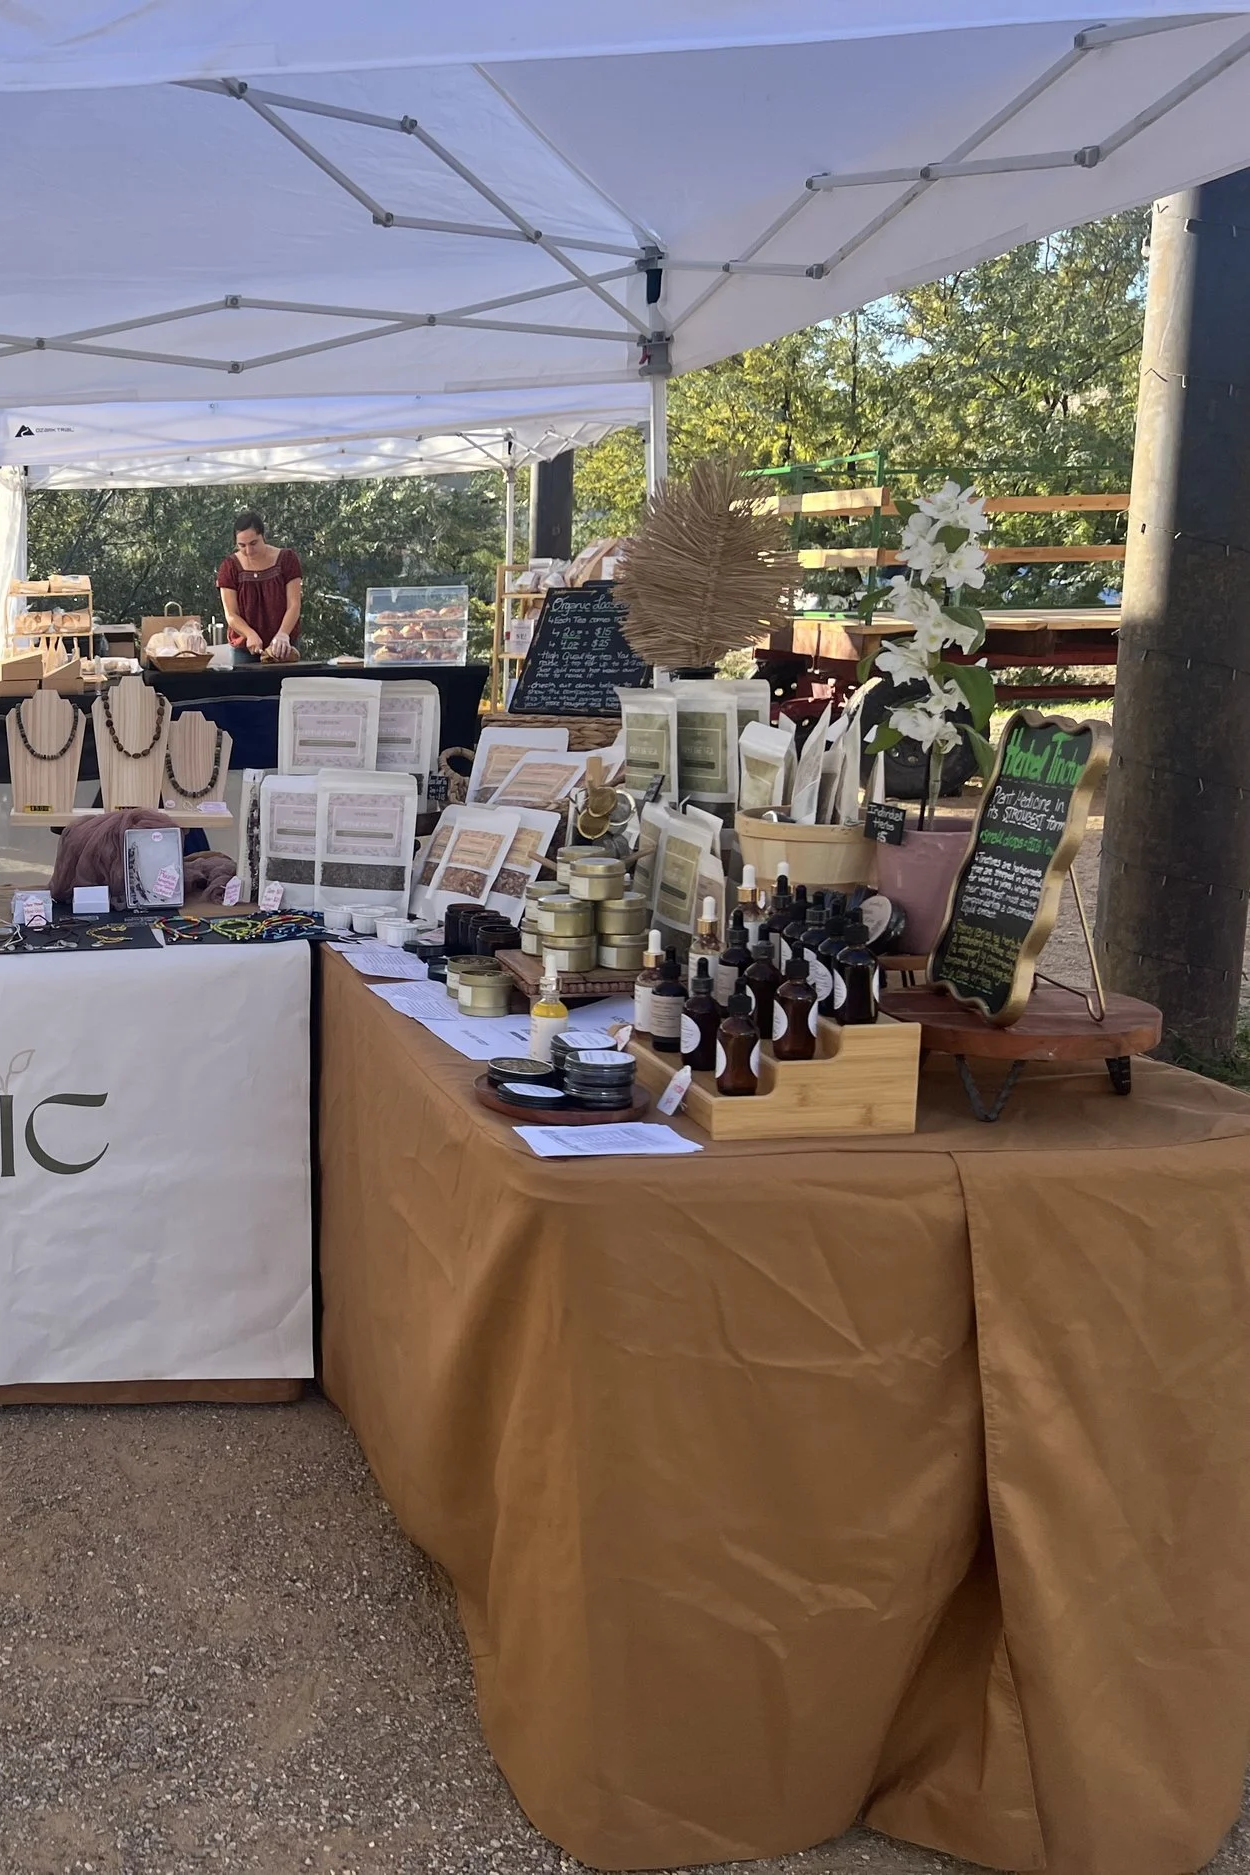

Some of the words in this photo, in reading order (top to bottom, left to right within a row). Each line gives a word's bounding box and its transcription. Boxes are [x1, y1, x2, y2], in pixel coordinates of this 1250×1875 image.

[552, 596, 591, 616] Organic
[595, 627, 616, 637] $15
[591, 639, 610, 648] $25
[1013, 790, 1052, 812] Medicine
[1055, 798, 1065, 813] in
[872, 817, 895, 831] Herbs
[1003, 806, 1047, 829] STRONGEST
[876, 831, 888, 843] $5
